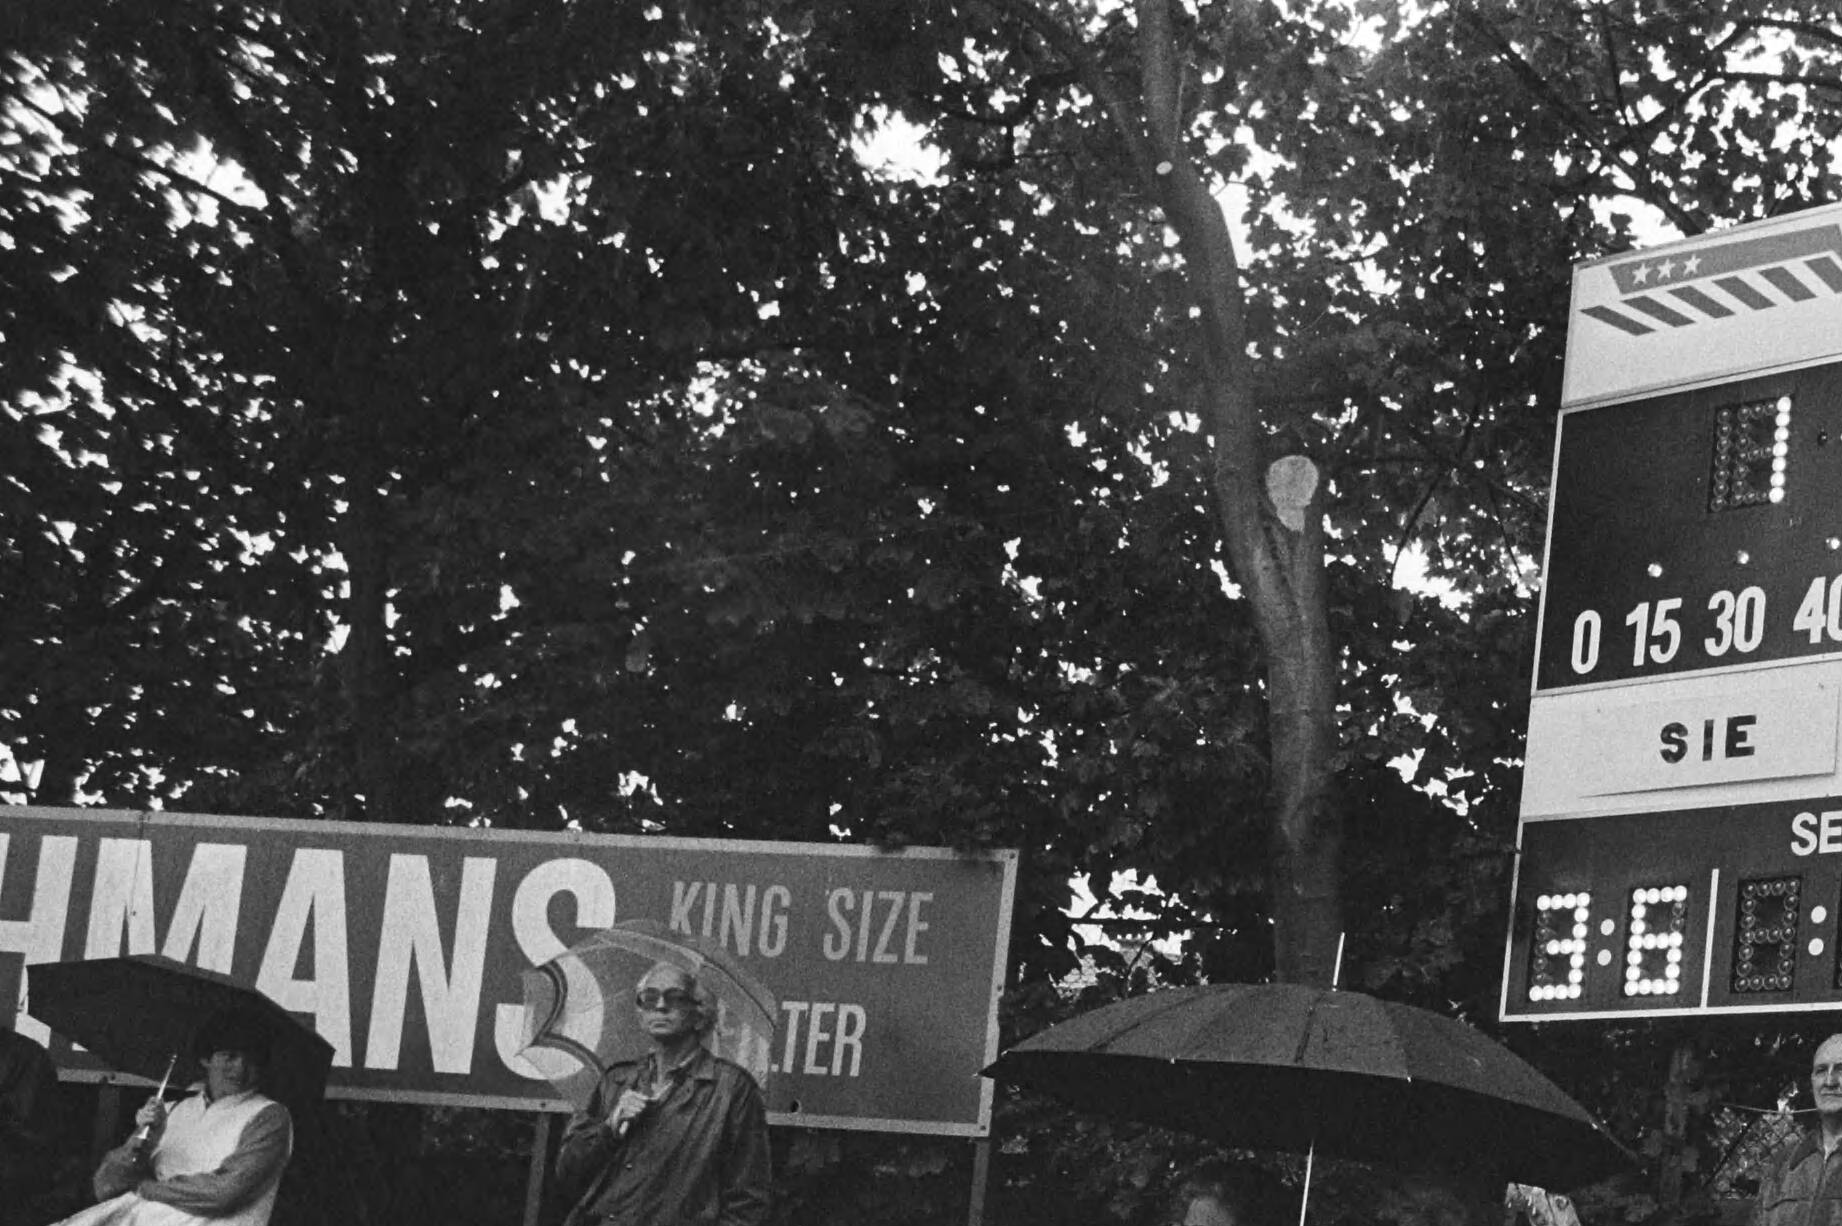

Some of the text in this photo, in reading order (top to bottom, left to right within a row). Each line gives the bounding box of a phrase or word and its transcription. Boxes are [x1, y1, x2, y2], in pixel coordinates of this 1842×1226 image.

[1571, 609, 1601, 675] 0
[1625, 597, 1682, 667] 15
[1704, 586, 1766, 657] 30
[1660, 714, 1757, 764] SIE
[669, 880, 933, 964] KING SIZE
